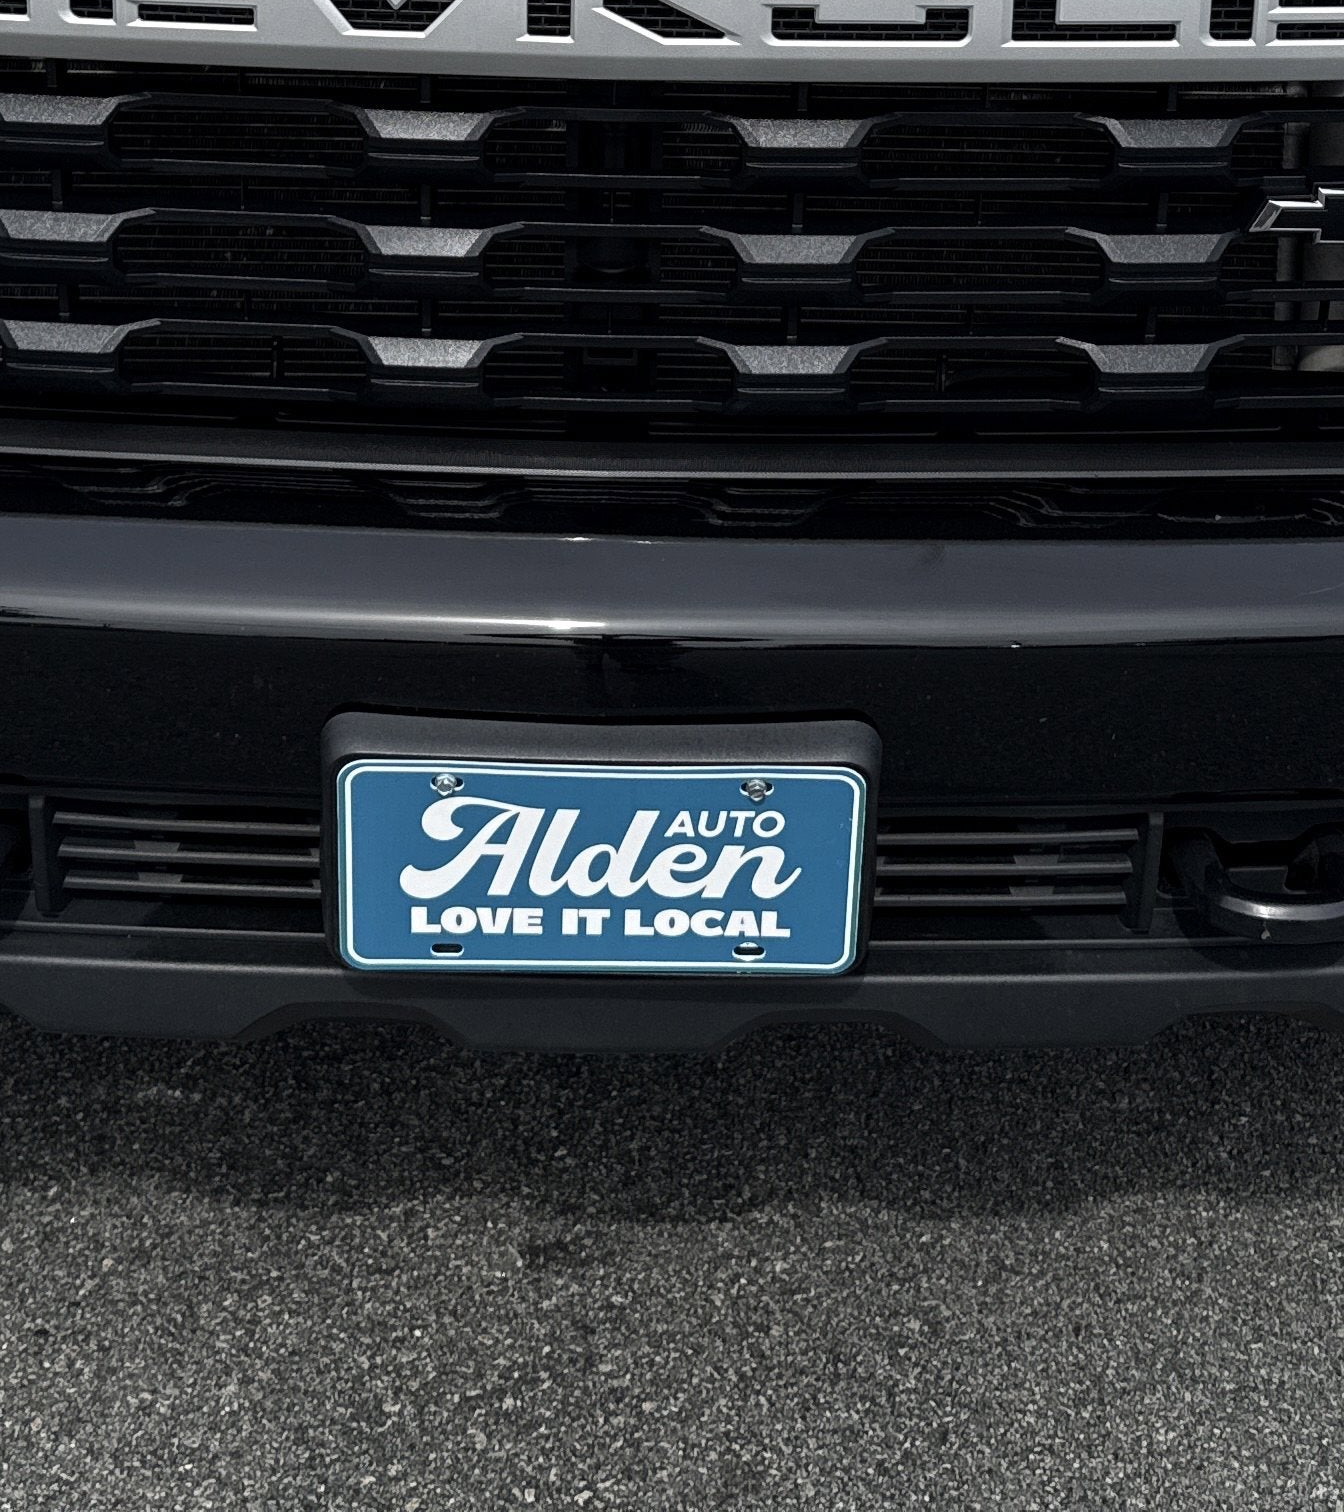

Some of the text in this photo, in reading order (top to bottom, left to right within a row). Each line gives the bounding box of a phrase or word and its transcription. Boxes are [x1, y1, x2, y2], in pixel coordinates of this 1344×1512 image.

[663, 809, 787, 839] AUTO
[399, 795, 802, 900] Alden
[410, 906, 791, 938] LOVE IT LOCAL
